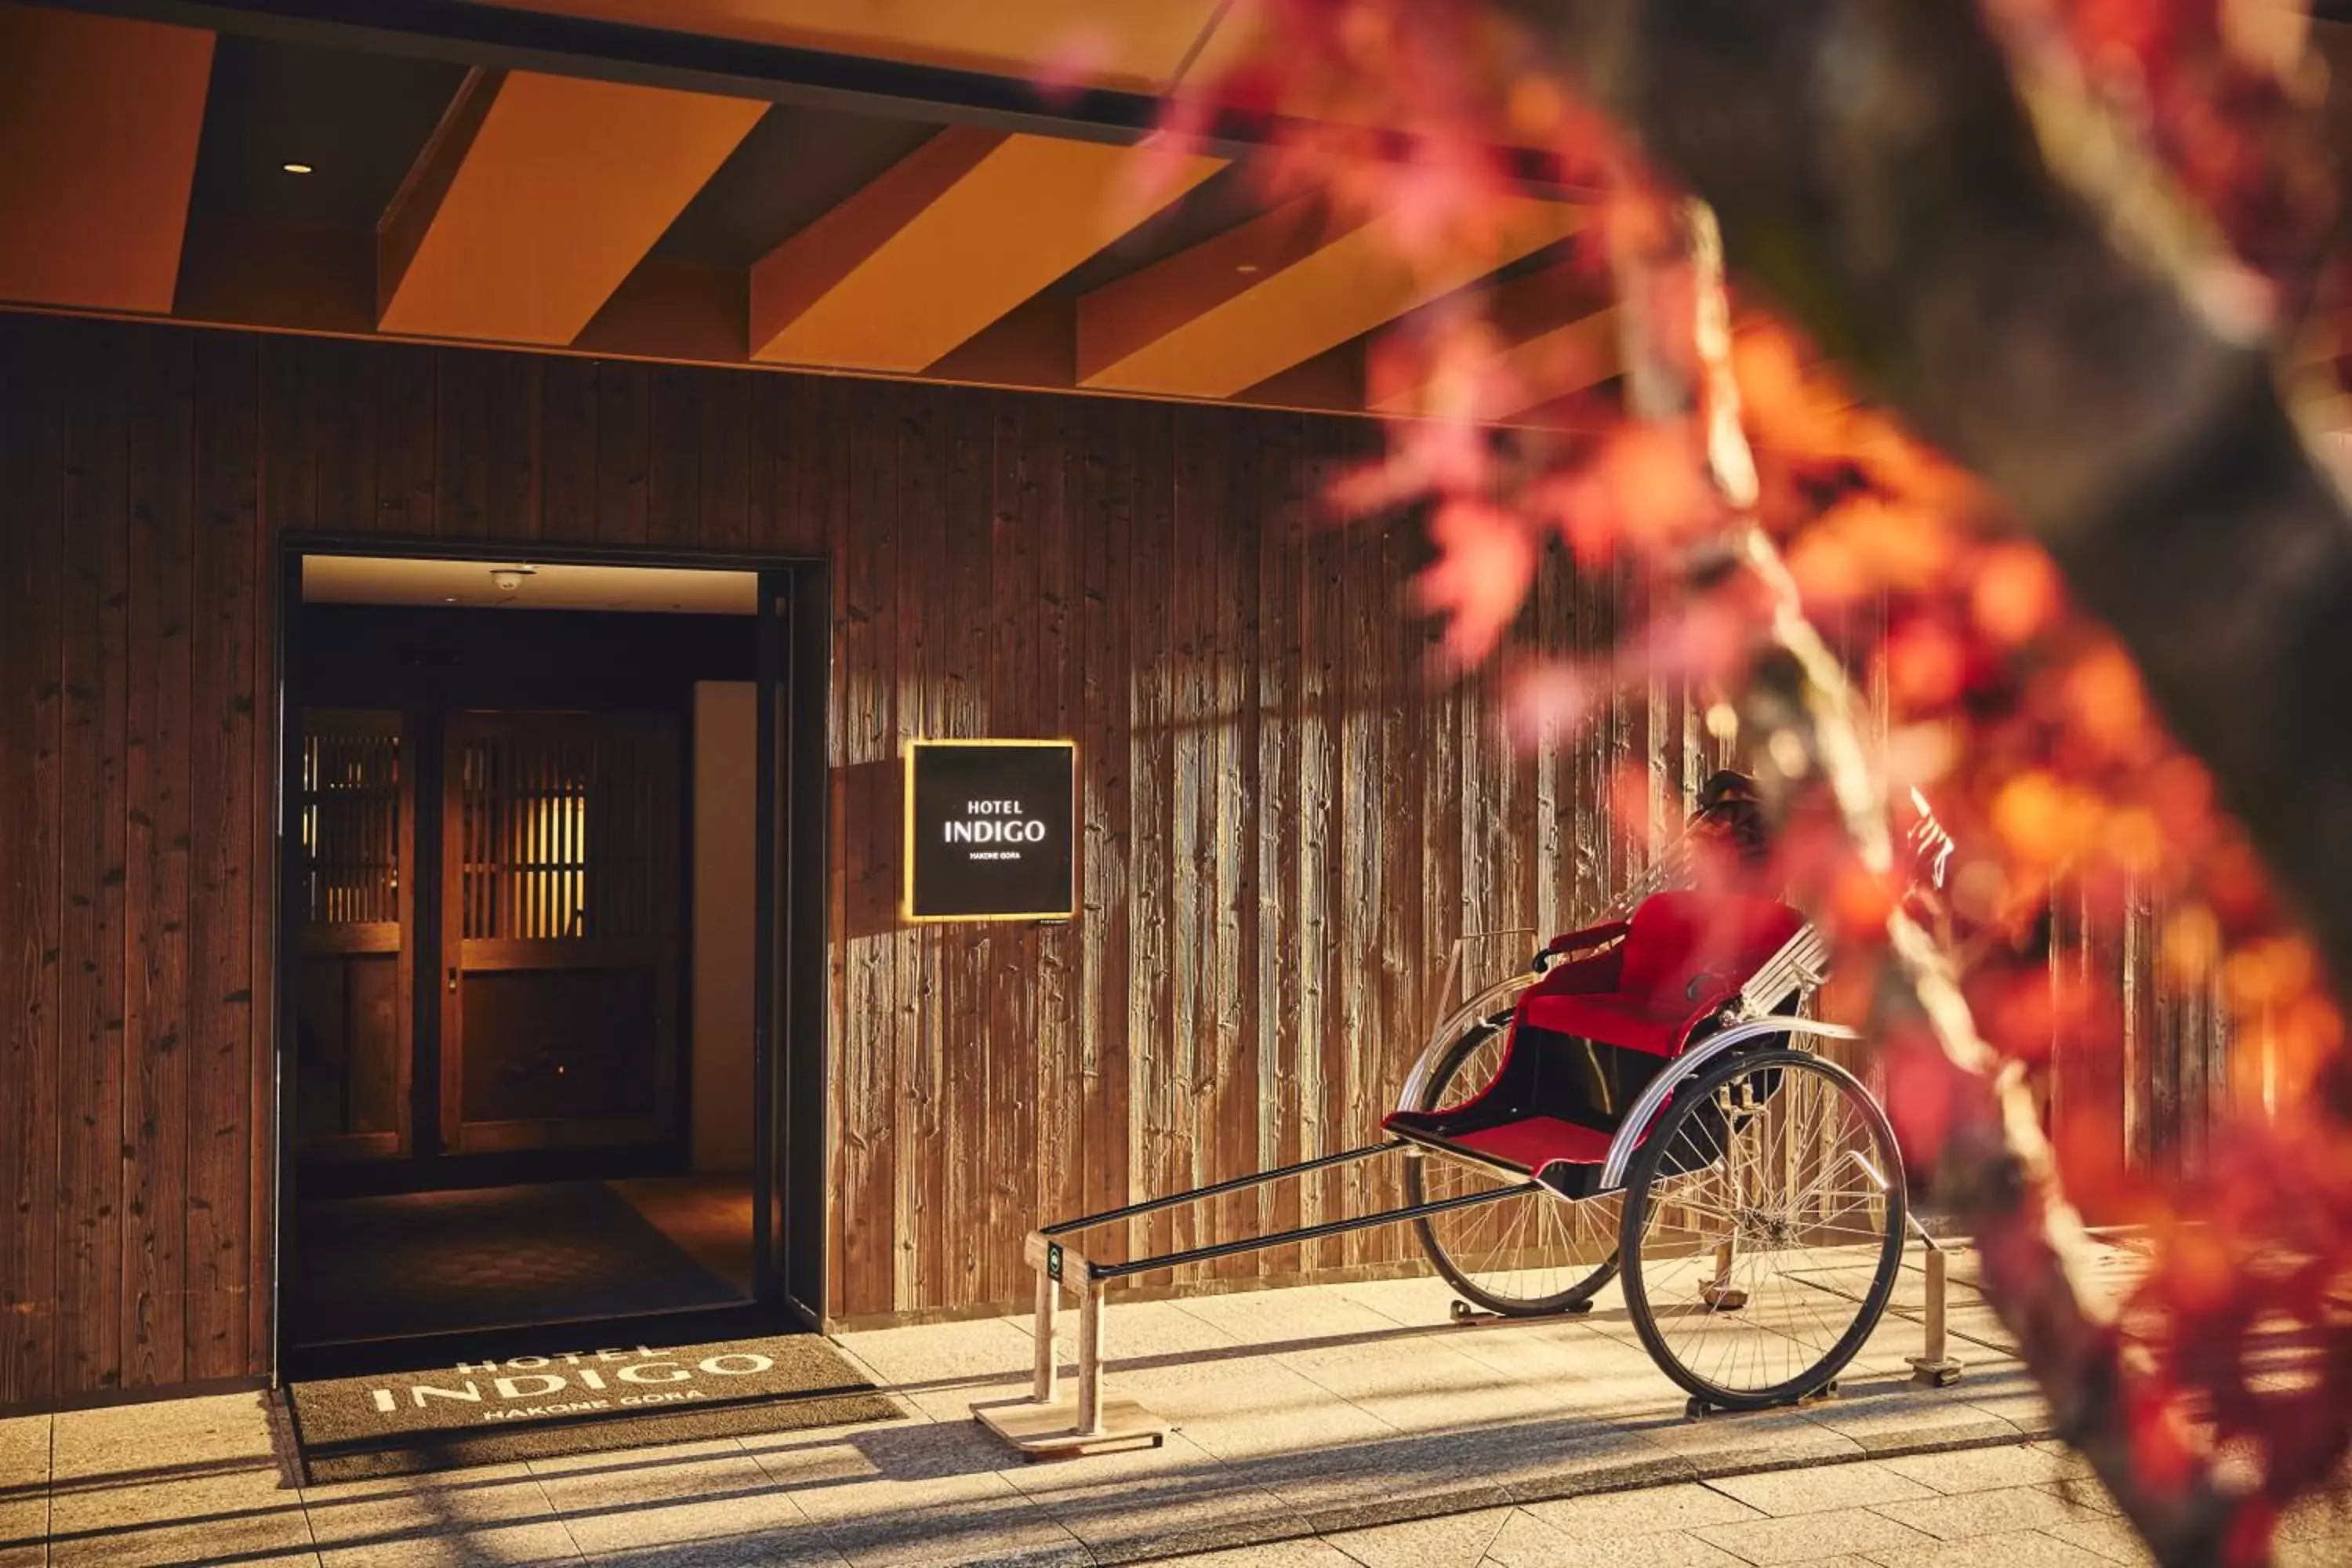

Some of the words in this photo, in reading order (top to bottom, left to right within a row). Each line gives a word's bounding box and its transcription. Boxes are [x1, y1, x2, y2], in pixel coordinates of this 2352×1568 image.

[968, 800, 1022, 815] HOTEL
[945, 820, 1046, 843] INDIGO
[456, 1345, 672, 1374] HOTEL
[372, 1353, 774, 1412] INDIGO
[483, 1399, 612, 1421] HAKONE
[620, 1390, 706, 1406] GORA
